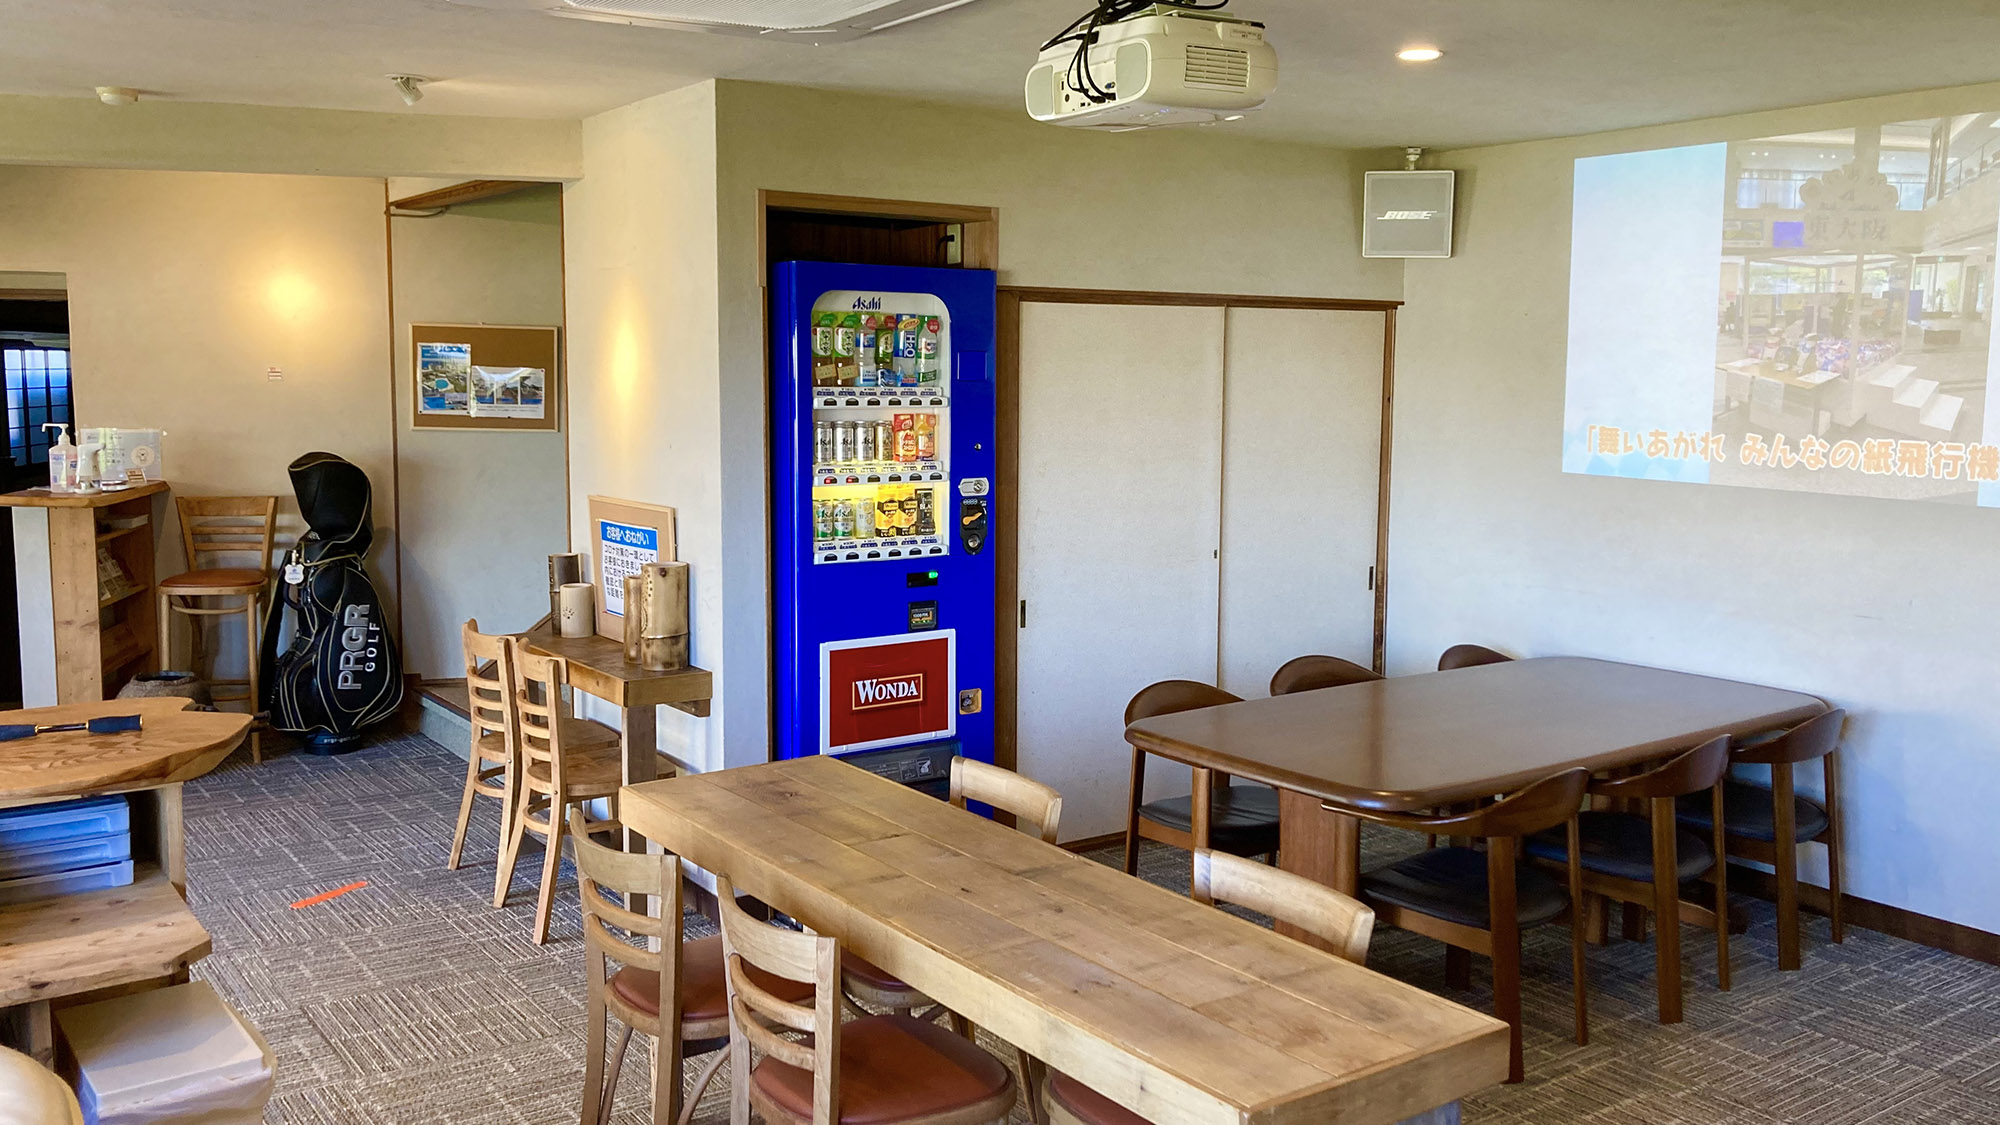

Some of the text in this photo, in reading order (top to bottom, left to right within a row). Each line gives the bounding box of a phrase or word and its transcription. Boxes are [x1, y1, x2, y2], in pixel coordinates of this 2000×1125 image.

[1377, 210, 1437, 220] BOSE
[852, 296, 881, 310] Asahi
[1587, 424, 2000, 481] 「舞いあがれ みんなの紙飛行機
[337, 603, 370, 690] PRGR
[365, 622, 381, 672] GOLF
[856, 679, 918, 704] WONDA
